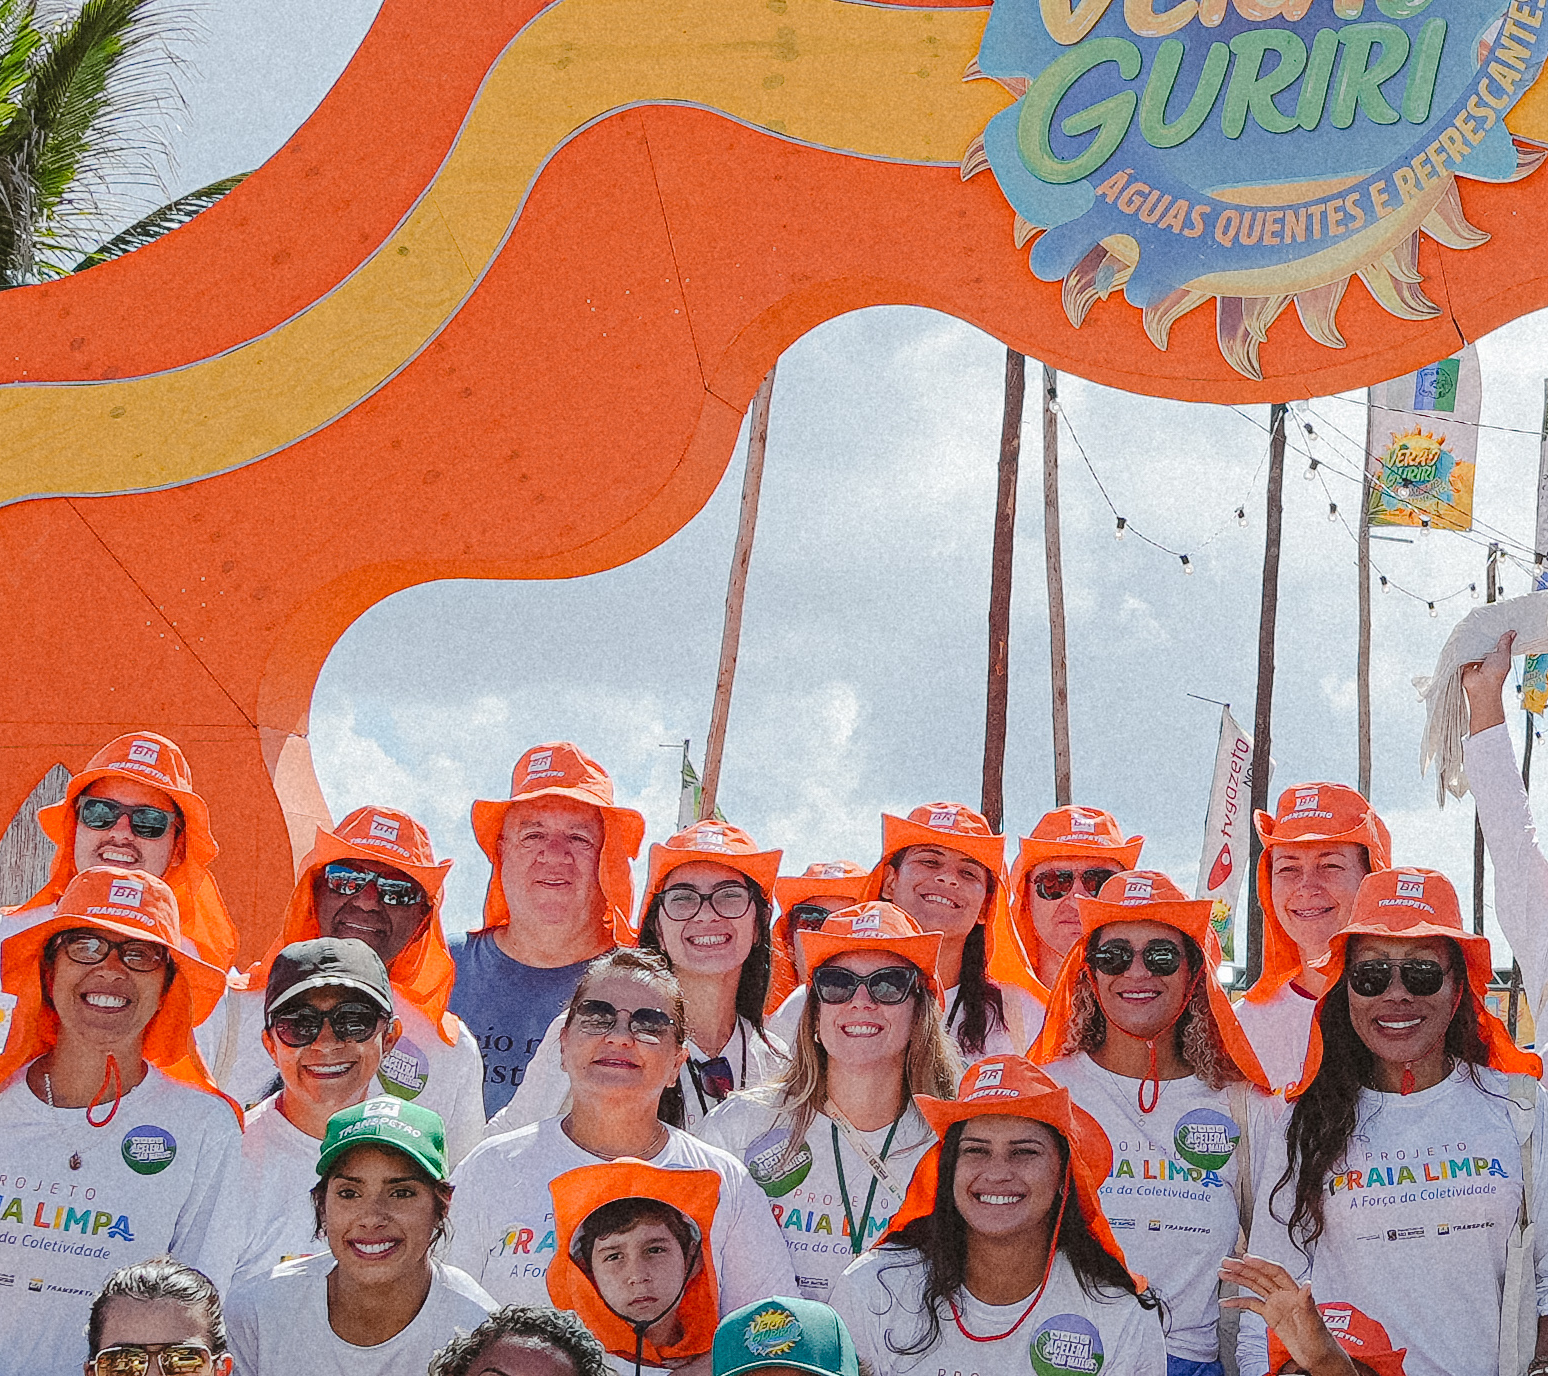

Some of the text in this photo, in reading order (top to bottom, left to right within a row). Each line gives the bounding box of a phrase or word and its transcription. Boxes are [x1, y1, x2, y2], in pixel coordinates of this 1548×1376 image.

[1018, 19, 1446, 184] GURIRI
[1094, 169, 1210, 238] ÁGUAS
[1214, 191, 1366, 247] QUENTES
[1372, 185, 1394, 216] E
[87, 905, 155, 926] TRANSPETRO
[338, 1116, 422, 1139] TRANSPETRO
[1364, 1142, 1468, 1161] PROJETO
[1328, 1156, 1508, 1195] PRAIA LIMPA
[1137, 1185, 1211, 1202] Coletividade
[1362, 1184, 1497, 1209] Força da Coletividade
[33, 1204, 135, 1242] LIMPA
[0, 1231, 17, 1244] da
[22, 1233, 111, 1259] Coletividade
